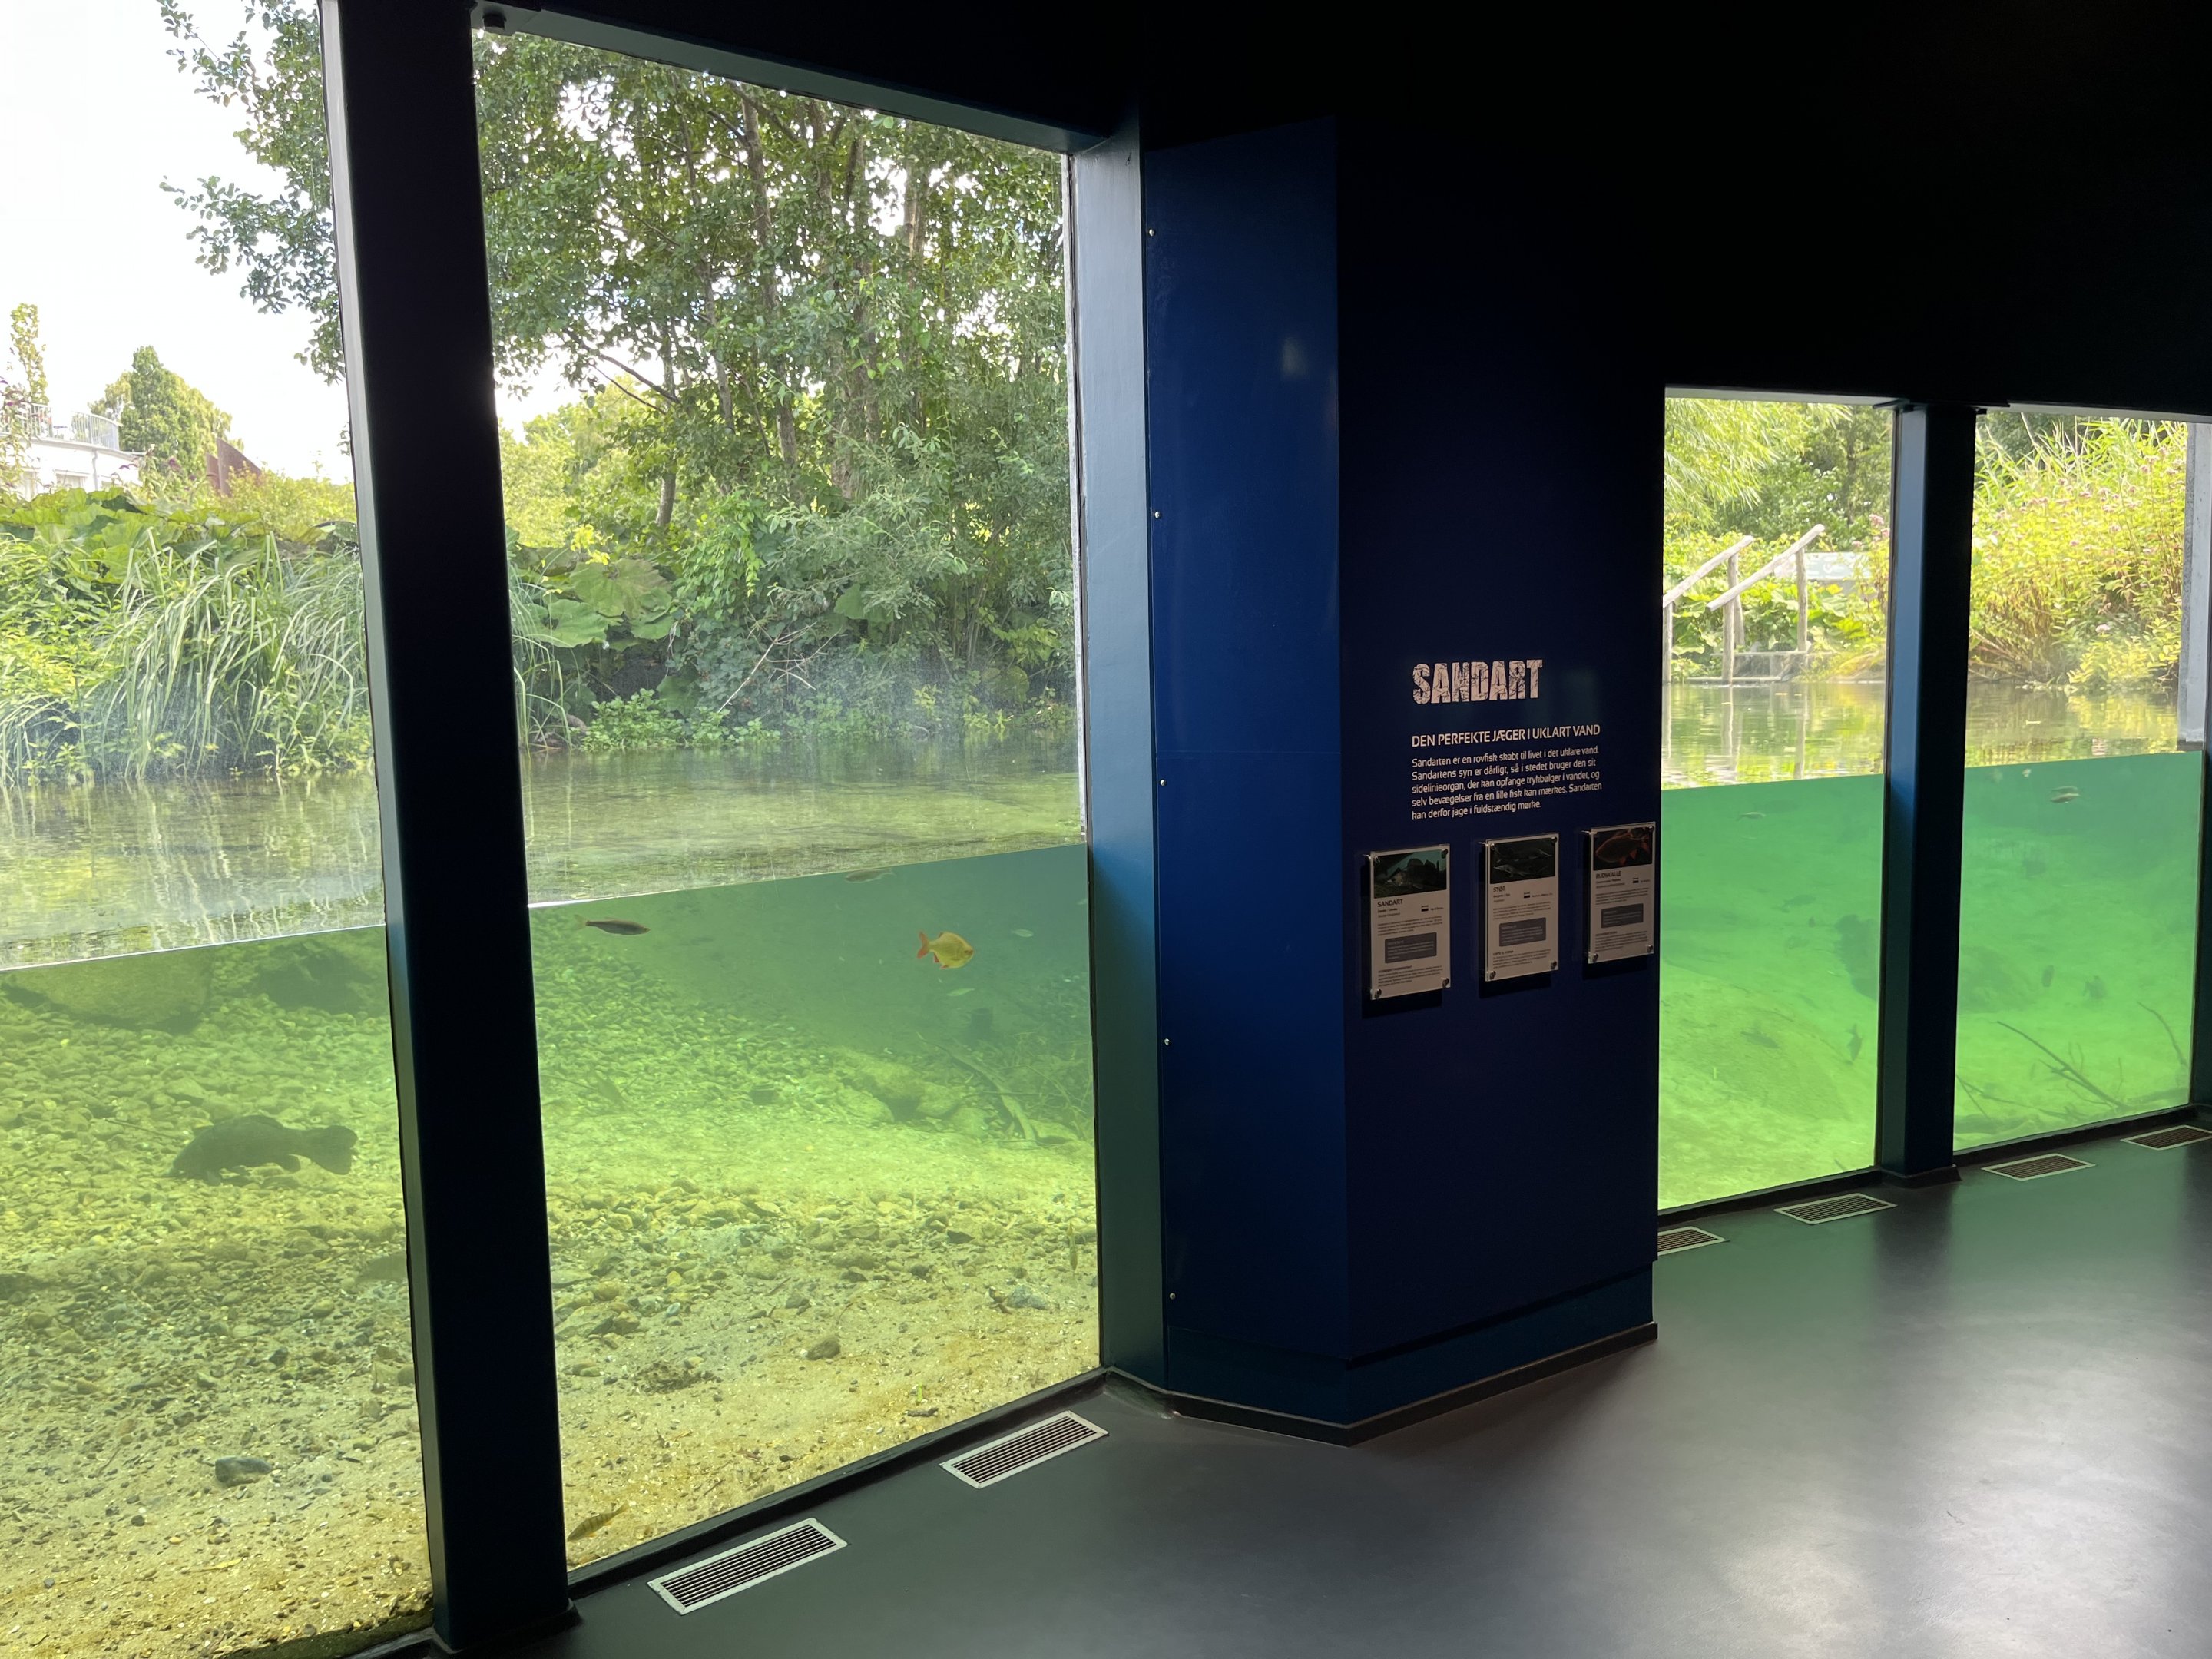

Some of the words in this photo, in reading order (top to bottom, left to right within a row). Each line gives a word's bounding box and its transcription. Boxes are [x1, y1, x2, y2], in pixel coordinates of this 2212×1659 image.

[1412, 659, 1542, 704] SANDART
[1412, 734, 1435, 747] DEN
[1438, 731, 1490, 745] PERFEKTE
[1492, 729, 1525, 741] JÆGER
[1532, 727, 1571, 739] UKLART
[1573, 724, 1600, 737] VAND
[1412, 757, 1451, 767] Sandarten
[1473, 753, 1497, 763] rovfisk
[1499, 750, 1518, 760] skabt
[1528, 750, 1541, 759] livet
[1548, 749, 1558, 757] det
[1560, 748, 1580, 757] uklare
[1412, 770, 1456, 780] Sandartens
[1459, 770, 1472, 779] syn
[1511, 763, 1519, 773] så
[1525, 762, 1547, 771] stedet
[1549, 761, 1571, 770] bruger
[1412, 782, 1465, 793] sidelinieorgan,
[1468, 780, 1479, 789] der
[1496, 777, 1525, 787] opfange
[1527, 773, 1561, 786] trykbølger
[1566, 771, 1589, 780] vandet,
[1591, 771, 1599, 780] og
[1412, 798, 1427, 806] selv
[1429, 794, 1472, 805] bevægelser
[1474, 793, 1483, 801] fra
[1496, 790, 1507, 799] lille
[1510, 790, 1522, 798] fisk
[1569, 783, 1602, 793] Sandarten
[1412, 811, 1426, 820] kan
[1428, 808, 1450, 818] derfor
[1452, 808, 1468, 818] jage
[1474, 802, 1516, 813] fuldstændig
[1377, 899, 1403, 908] SANDART
